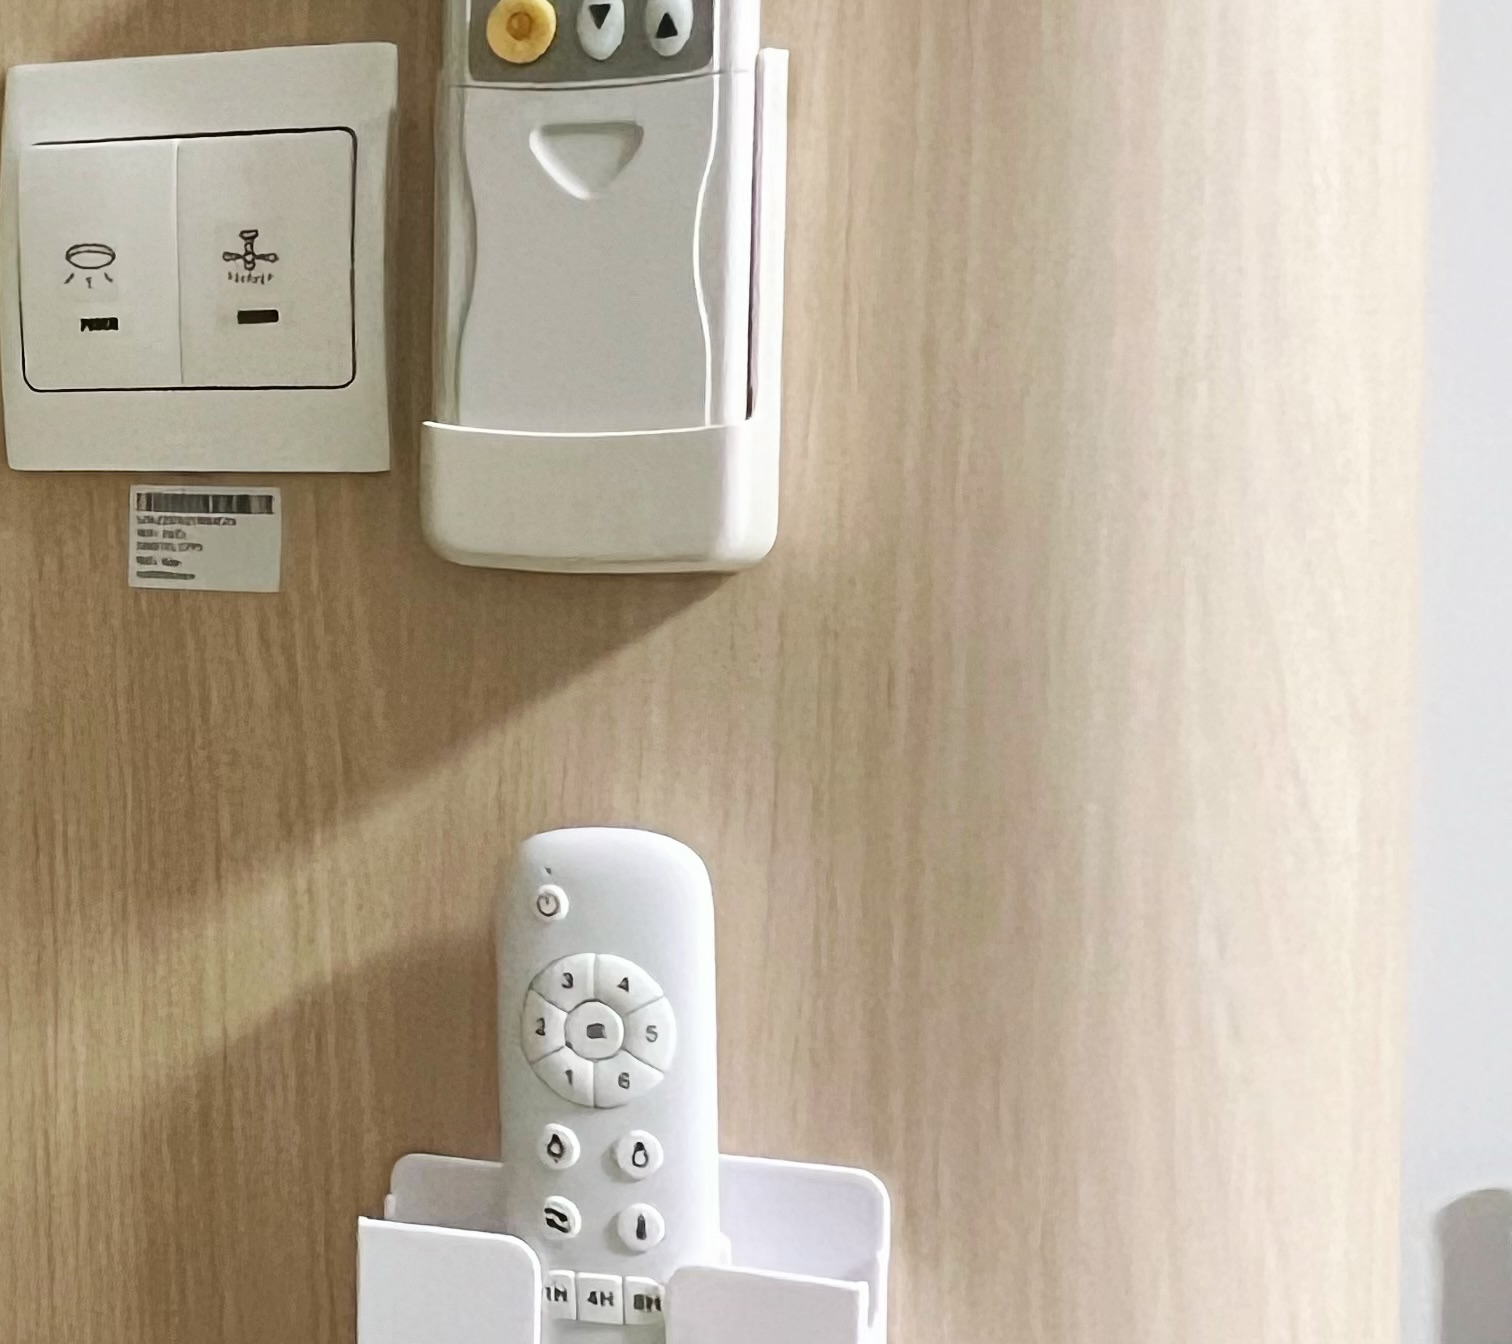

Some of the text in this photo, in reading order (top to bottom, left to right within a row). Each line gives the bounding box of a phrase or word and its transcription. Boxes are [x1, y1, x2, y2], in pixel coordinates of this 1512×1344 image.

[561, 972, 574, 989] 3
[617, 976, 630, 992] 4
[535, 1017, 547, 1036] 2
[645, 1024, 659, 1043] 5
[564, 1068, 574, 1086] 1
[617, 1071, 631, 1089] 6
[587, 1291, 614, 1307] 4H
